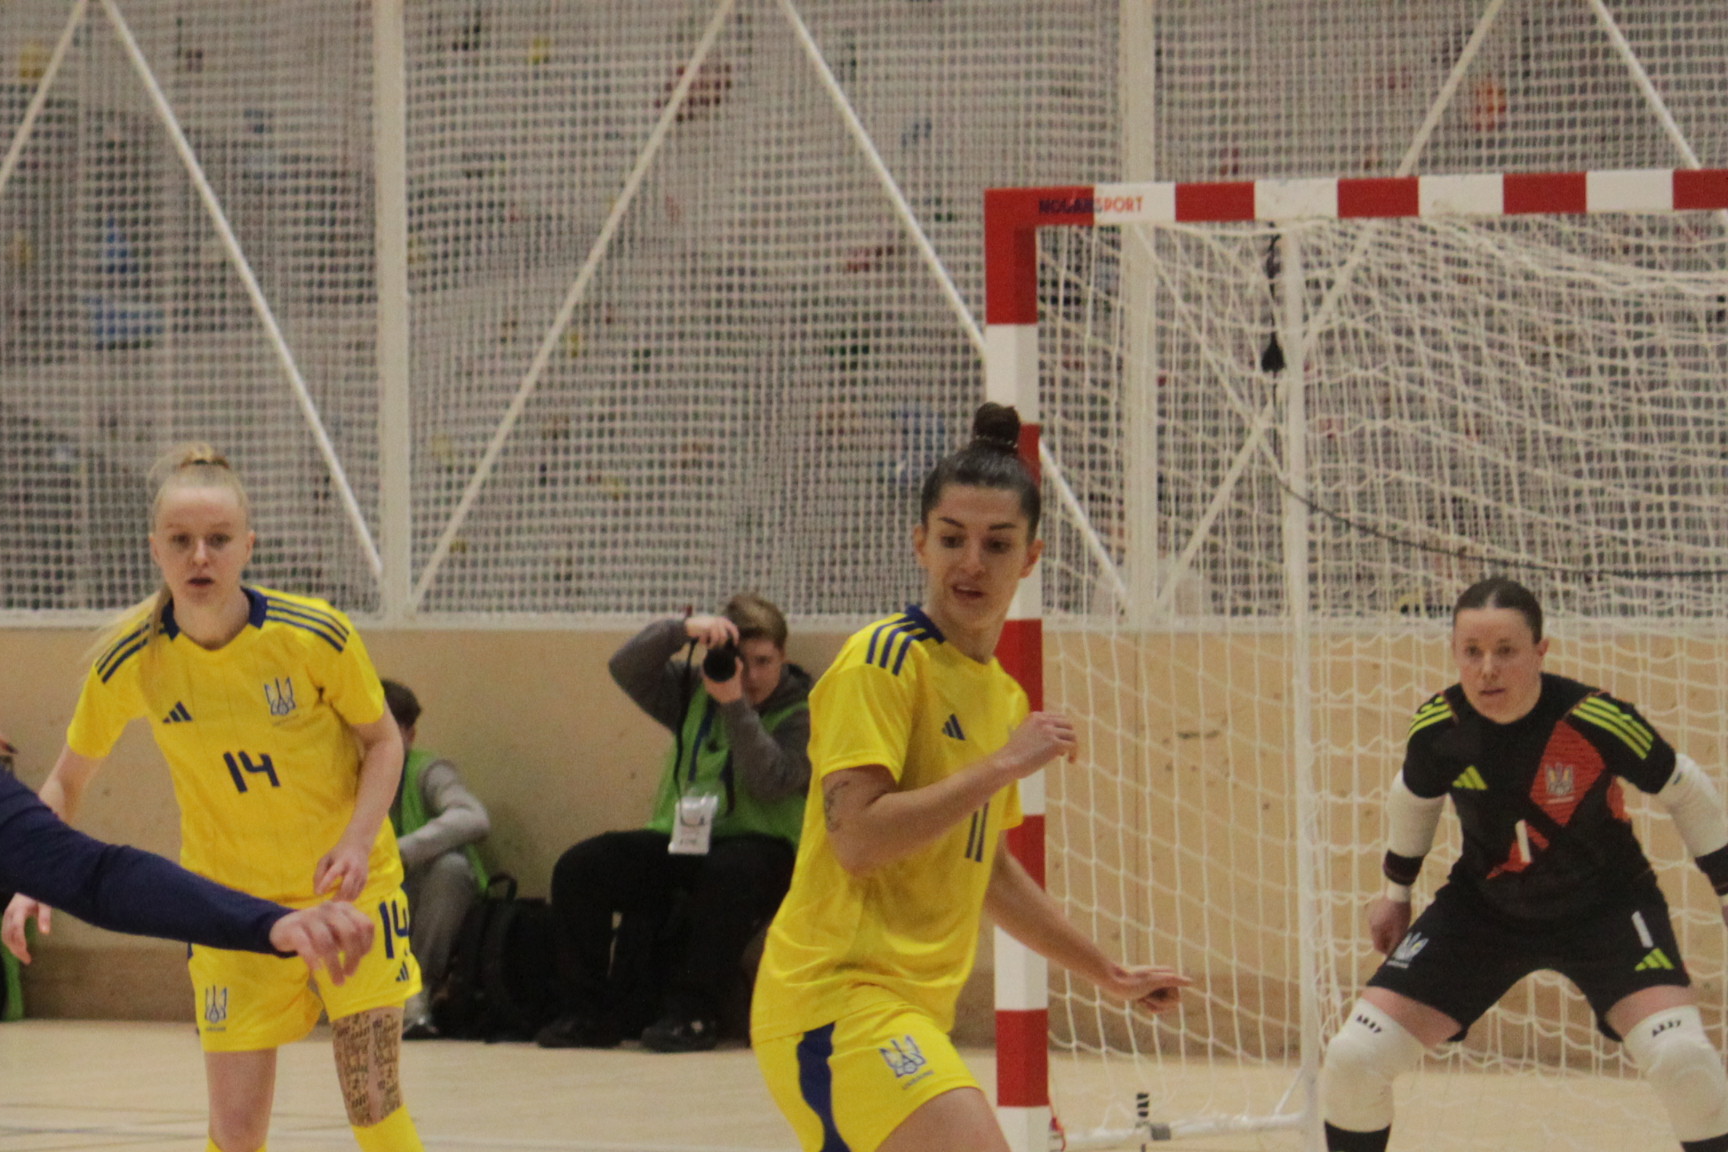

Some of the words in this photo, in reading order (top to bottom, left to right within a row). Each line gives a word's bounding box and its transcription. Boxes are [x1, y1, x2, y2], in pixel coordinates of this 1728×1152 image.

[223, 751, 281, 794] 14
[964, 801, 989, 863] 11
[1515, 819, 1532, 863] 1
[378, 900, 410, 960] 14
[1631, 910, 1654, 948] 1
